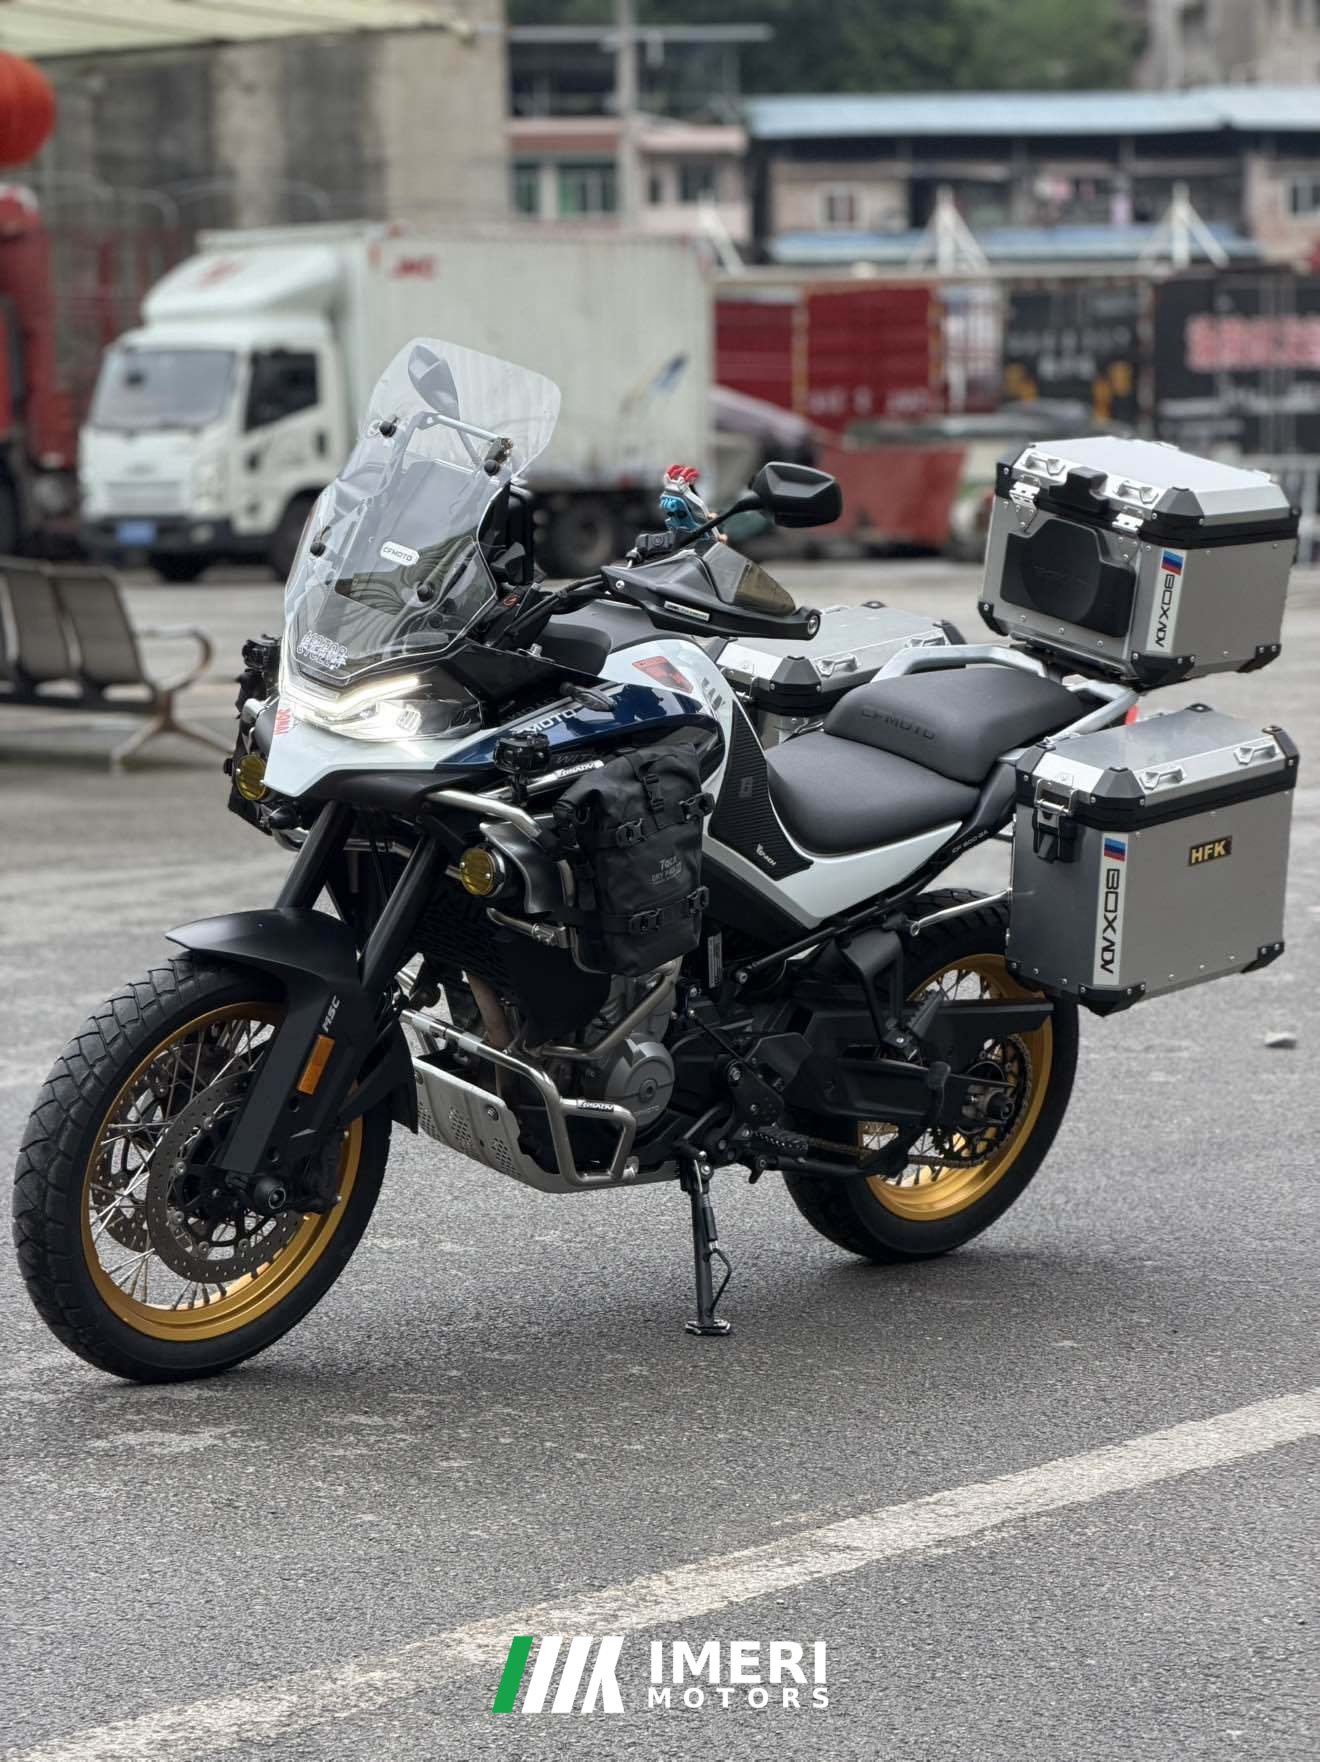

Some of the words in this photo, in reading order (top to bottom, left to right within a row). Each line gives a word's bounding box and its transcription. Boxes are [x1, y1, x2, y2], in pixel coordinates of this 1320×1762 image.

[383, 546, 413, 562] CFMOTO
[1190, 838, 1227, 865] HFK
[321, 994, 341, 1033] MSC
